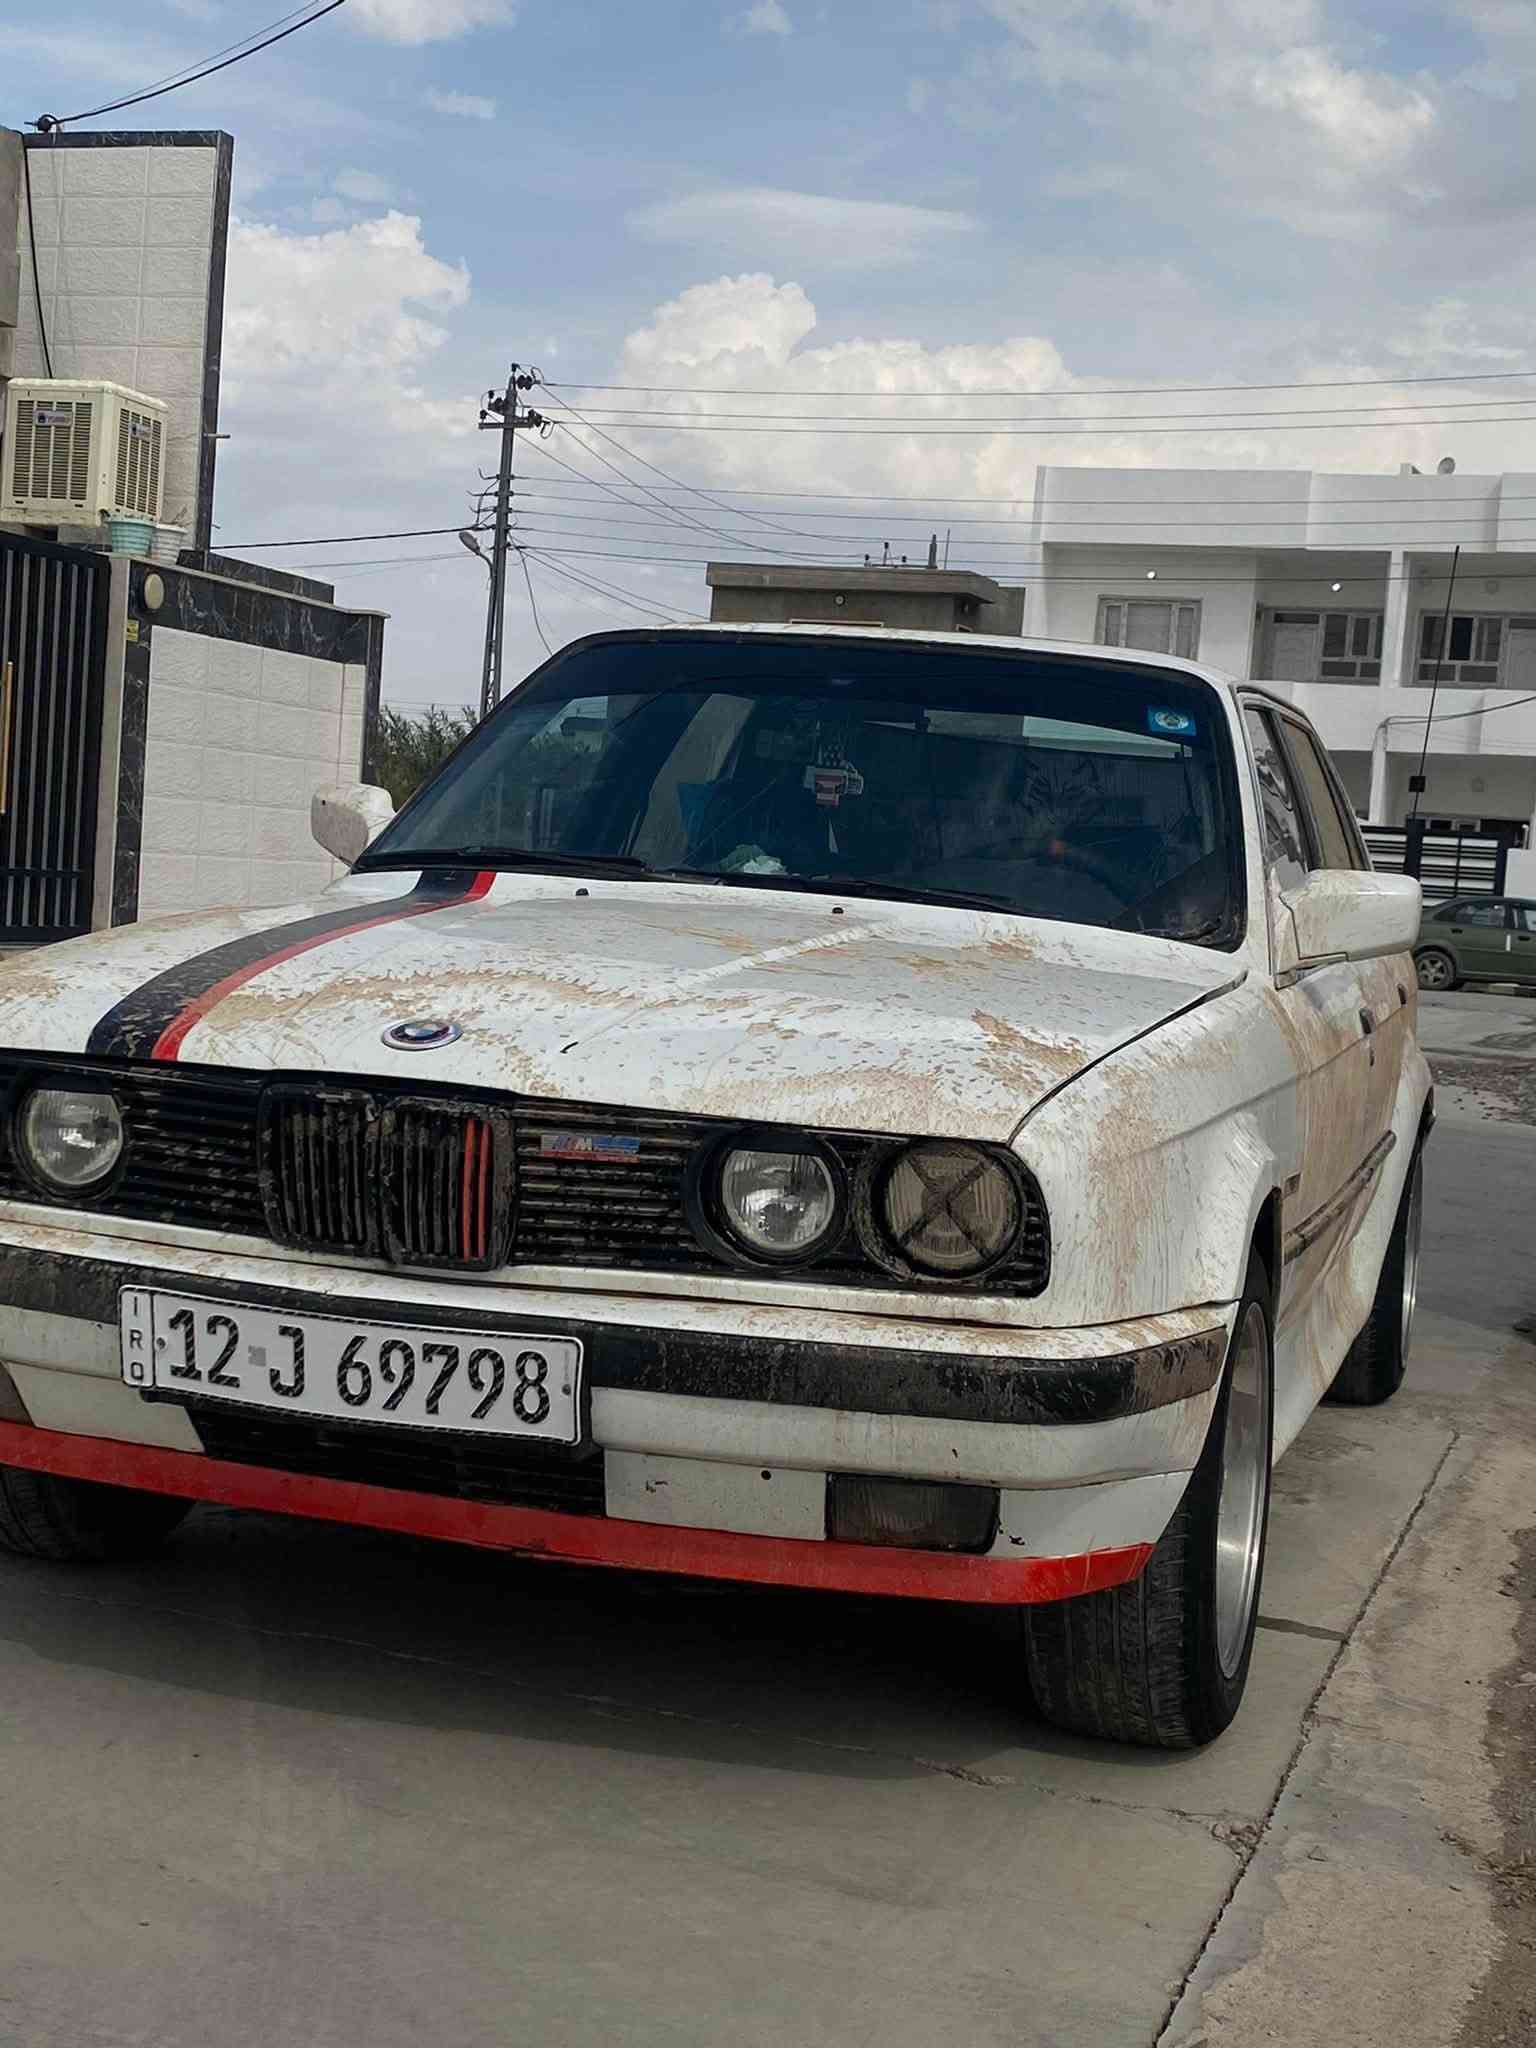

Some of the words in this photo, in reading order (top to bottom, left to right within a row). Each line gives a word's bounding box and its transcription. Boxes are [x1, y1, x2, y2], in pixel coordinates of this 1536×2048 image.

[169, 1308, 240, 1389] 12
[269, 1324, 304, 1397] J
[337, 1335, 550, 1424] 69798
